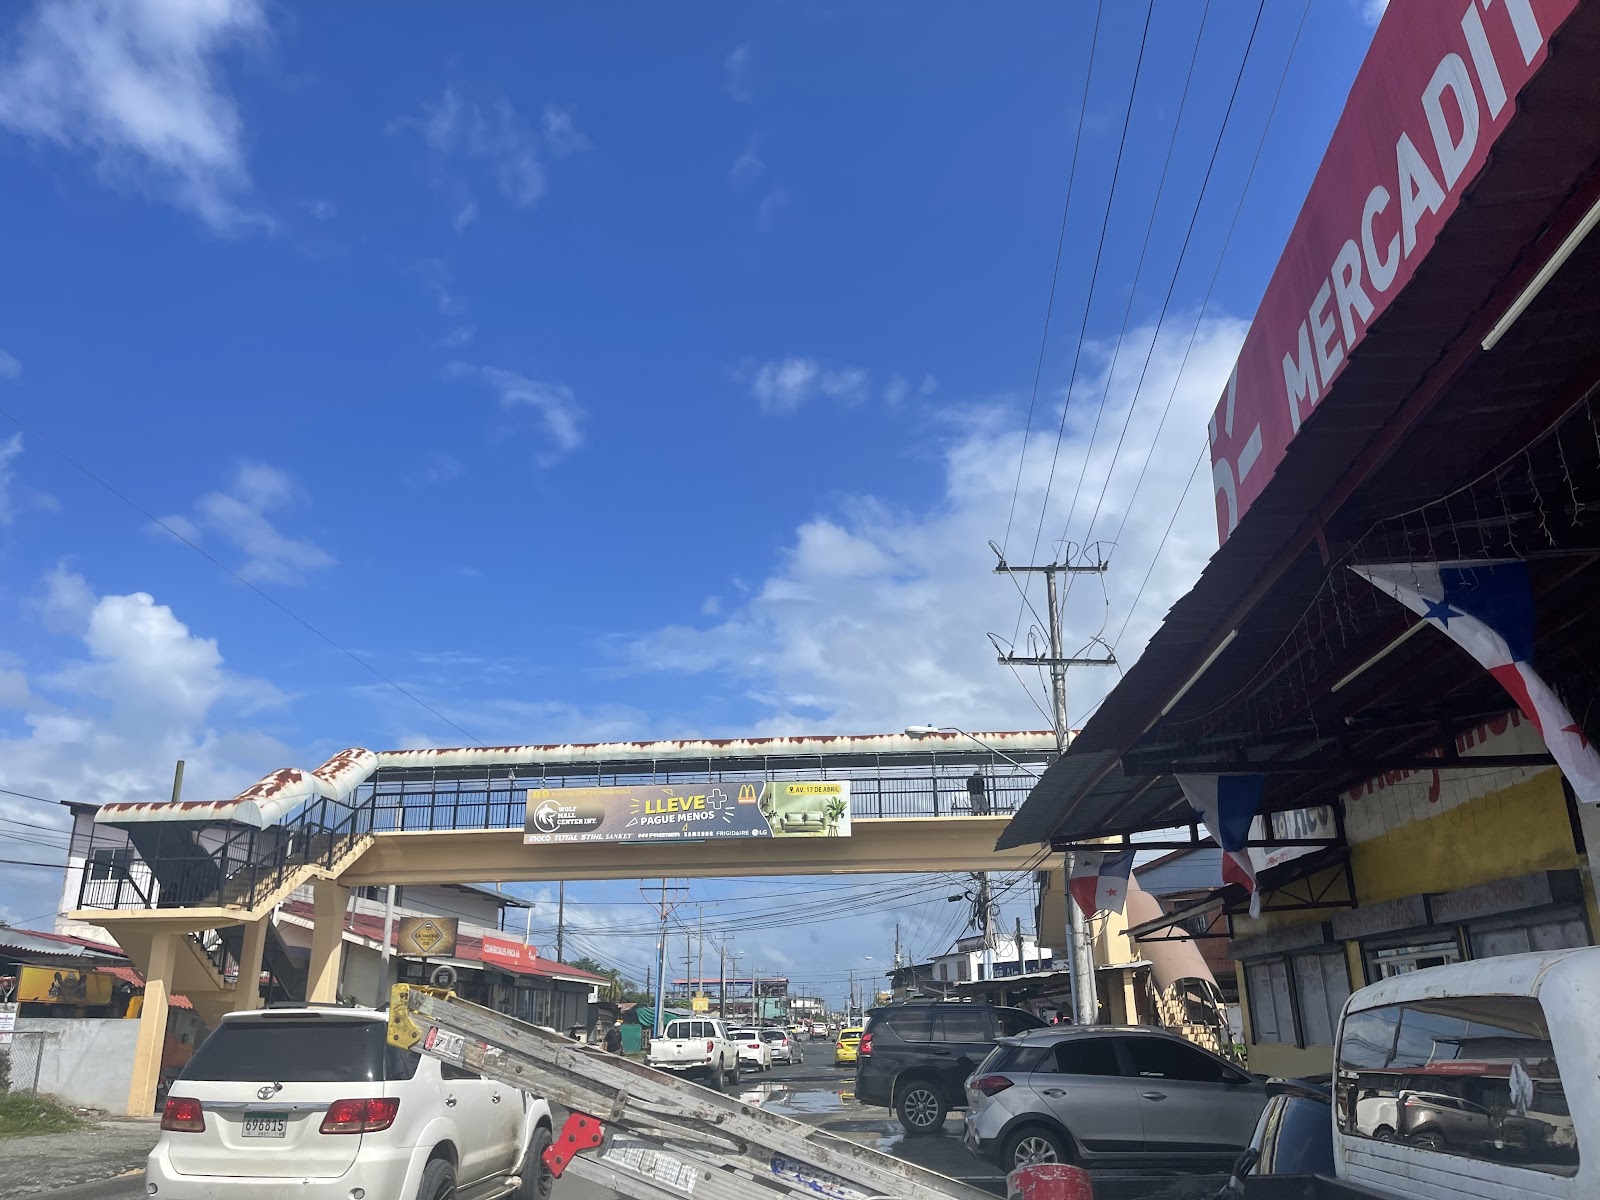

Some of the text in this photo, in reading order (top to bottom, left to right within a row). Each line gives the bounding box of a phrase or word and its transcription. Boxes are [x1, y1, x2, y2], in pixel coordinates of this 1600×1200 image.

[645, 795, 706, 815] LLEVE
[640, 810, 715, 826] PAGUE MENOS
[554, 833, 578, 841] TOTAL
[245, 1119, 284, 1131] 696815
